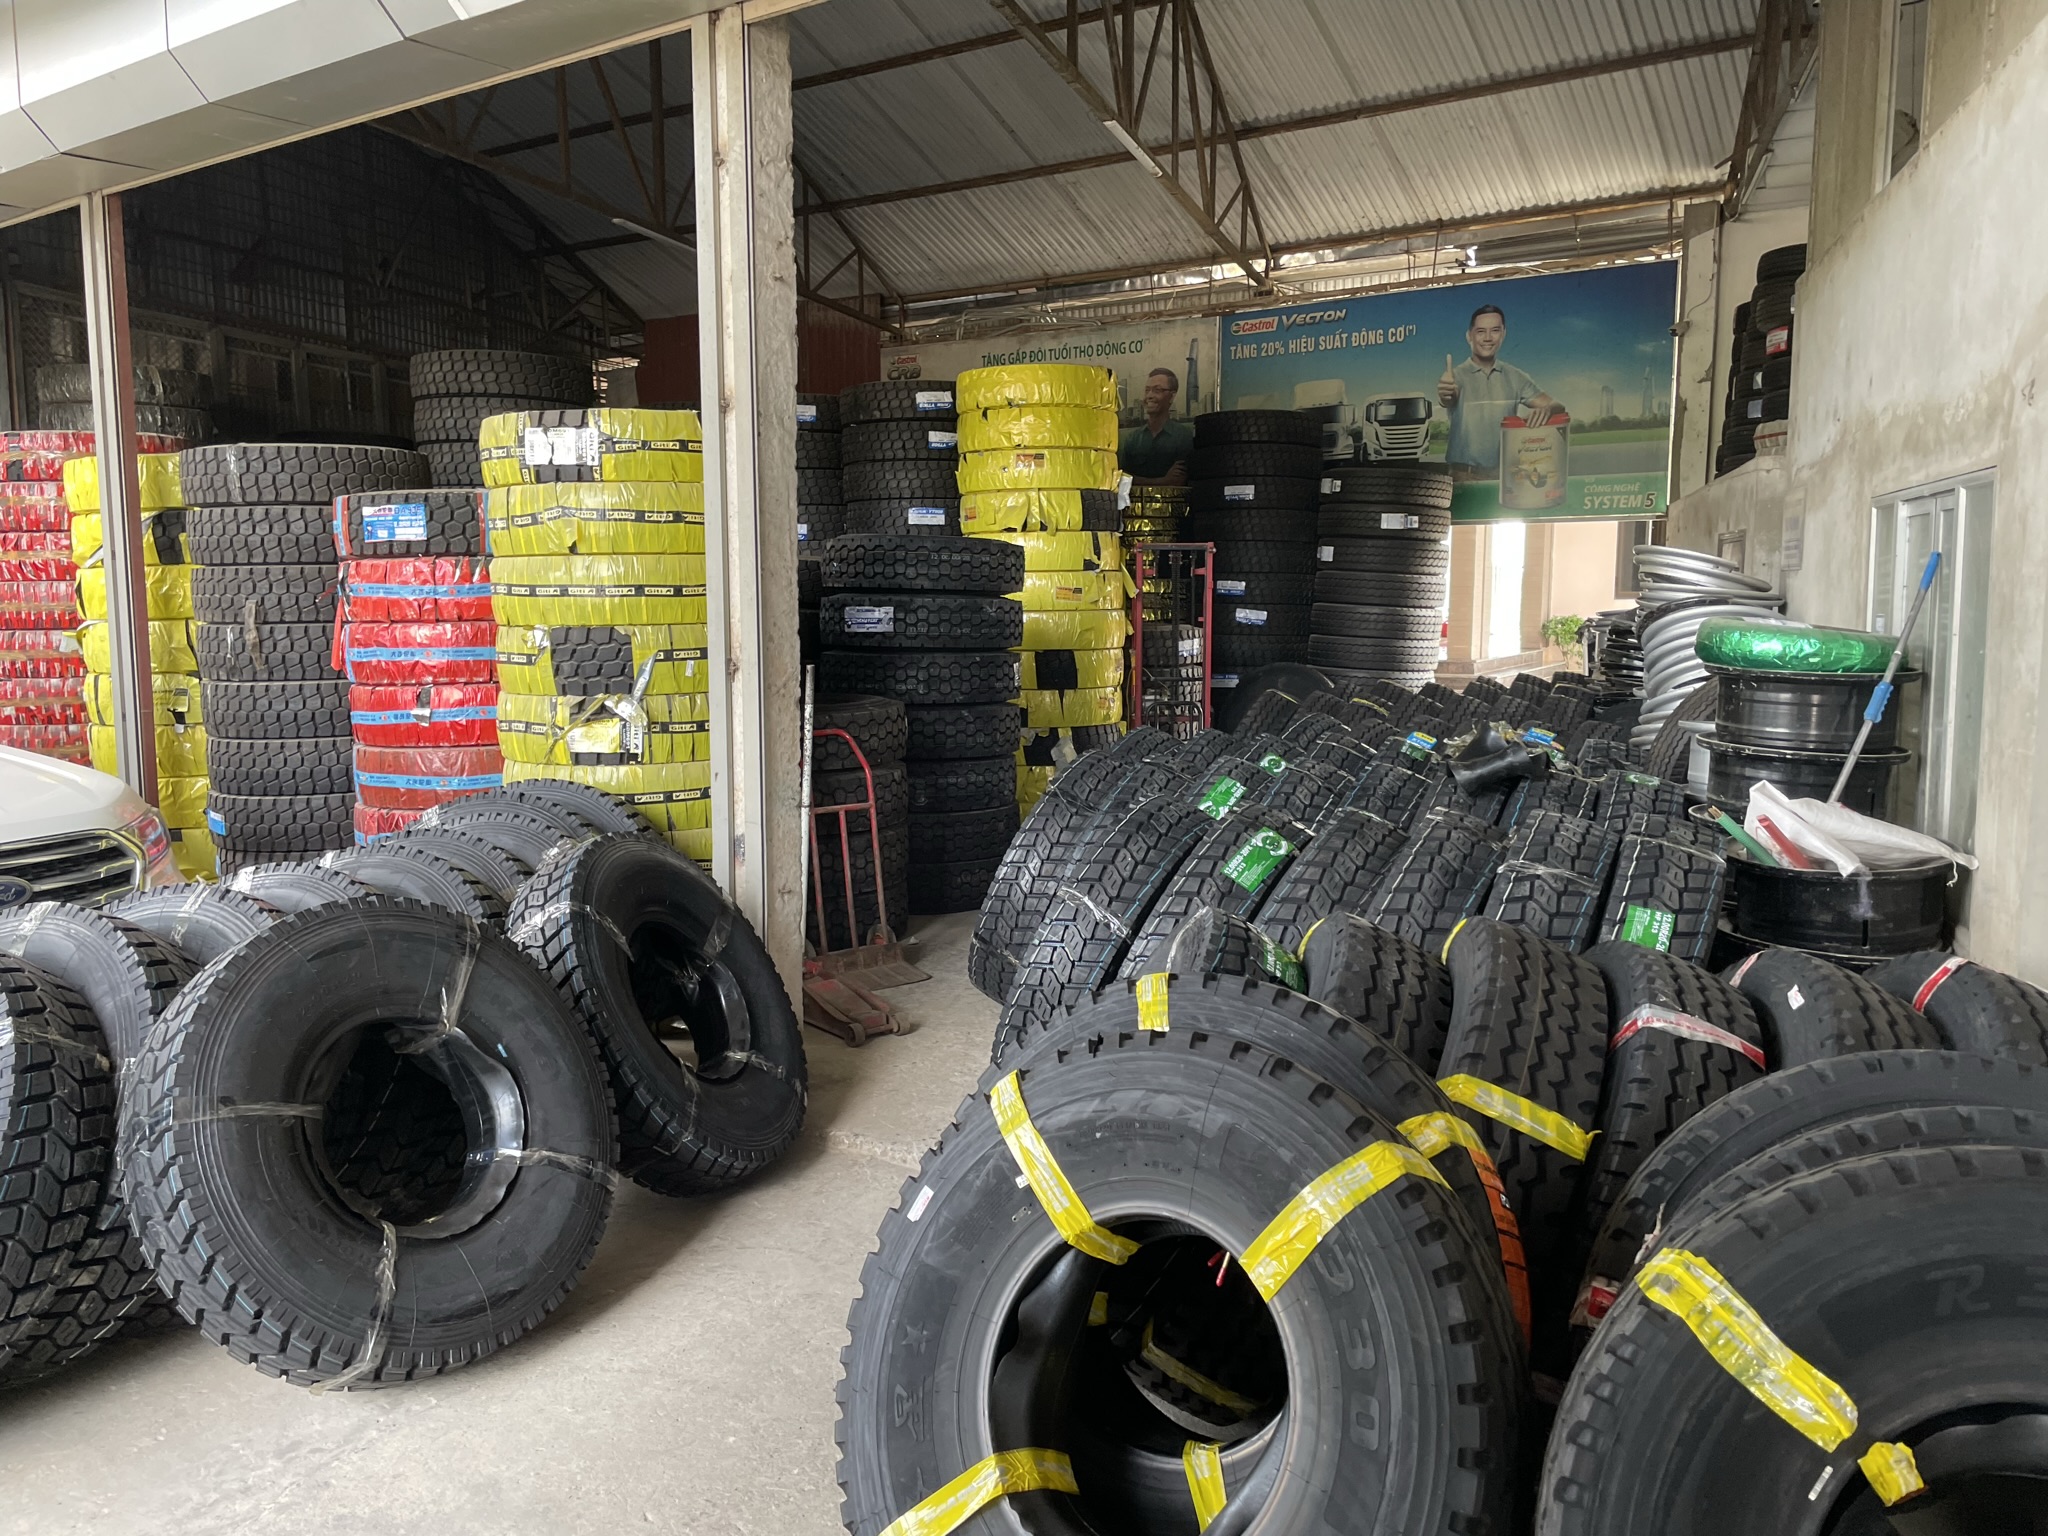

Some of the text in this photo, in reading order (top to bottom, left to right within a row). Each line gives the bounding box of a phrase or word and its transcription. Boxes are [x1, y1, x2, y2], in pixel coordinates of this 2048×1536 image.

[1241, 309, 1347, 333] Castrol VECTON
[1230, 343, 1258, 360] TĂNG
[1261, 342, 1285, 357] 20%
[1289, 335, 1315, 356] HIỆU
[1318, 329, 1349, 350] SUẤT
[1352, 328, 1384, 350] ĐỘNG
[896, 354, 918, 365] Castrol
[982, 352, 1006, 367] TĂNG
[1007, 350, 1028, 365] GẤP
[1029, 349, 1048, 363] ĐÔI
[1049, 343, 1072, 361] TUỔI
[1073, 345, 1093, 361] THỌ
[1096, 341, 1127, 357] ĐỘNG
[887, 365, 921, 380] CRB
[1584, 484, 1612, 493] CÔNG
[1583, 492, 1657, 510] SYSTEM 5
